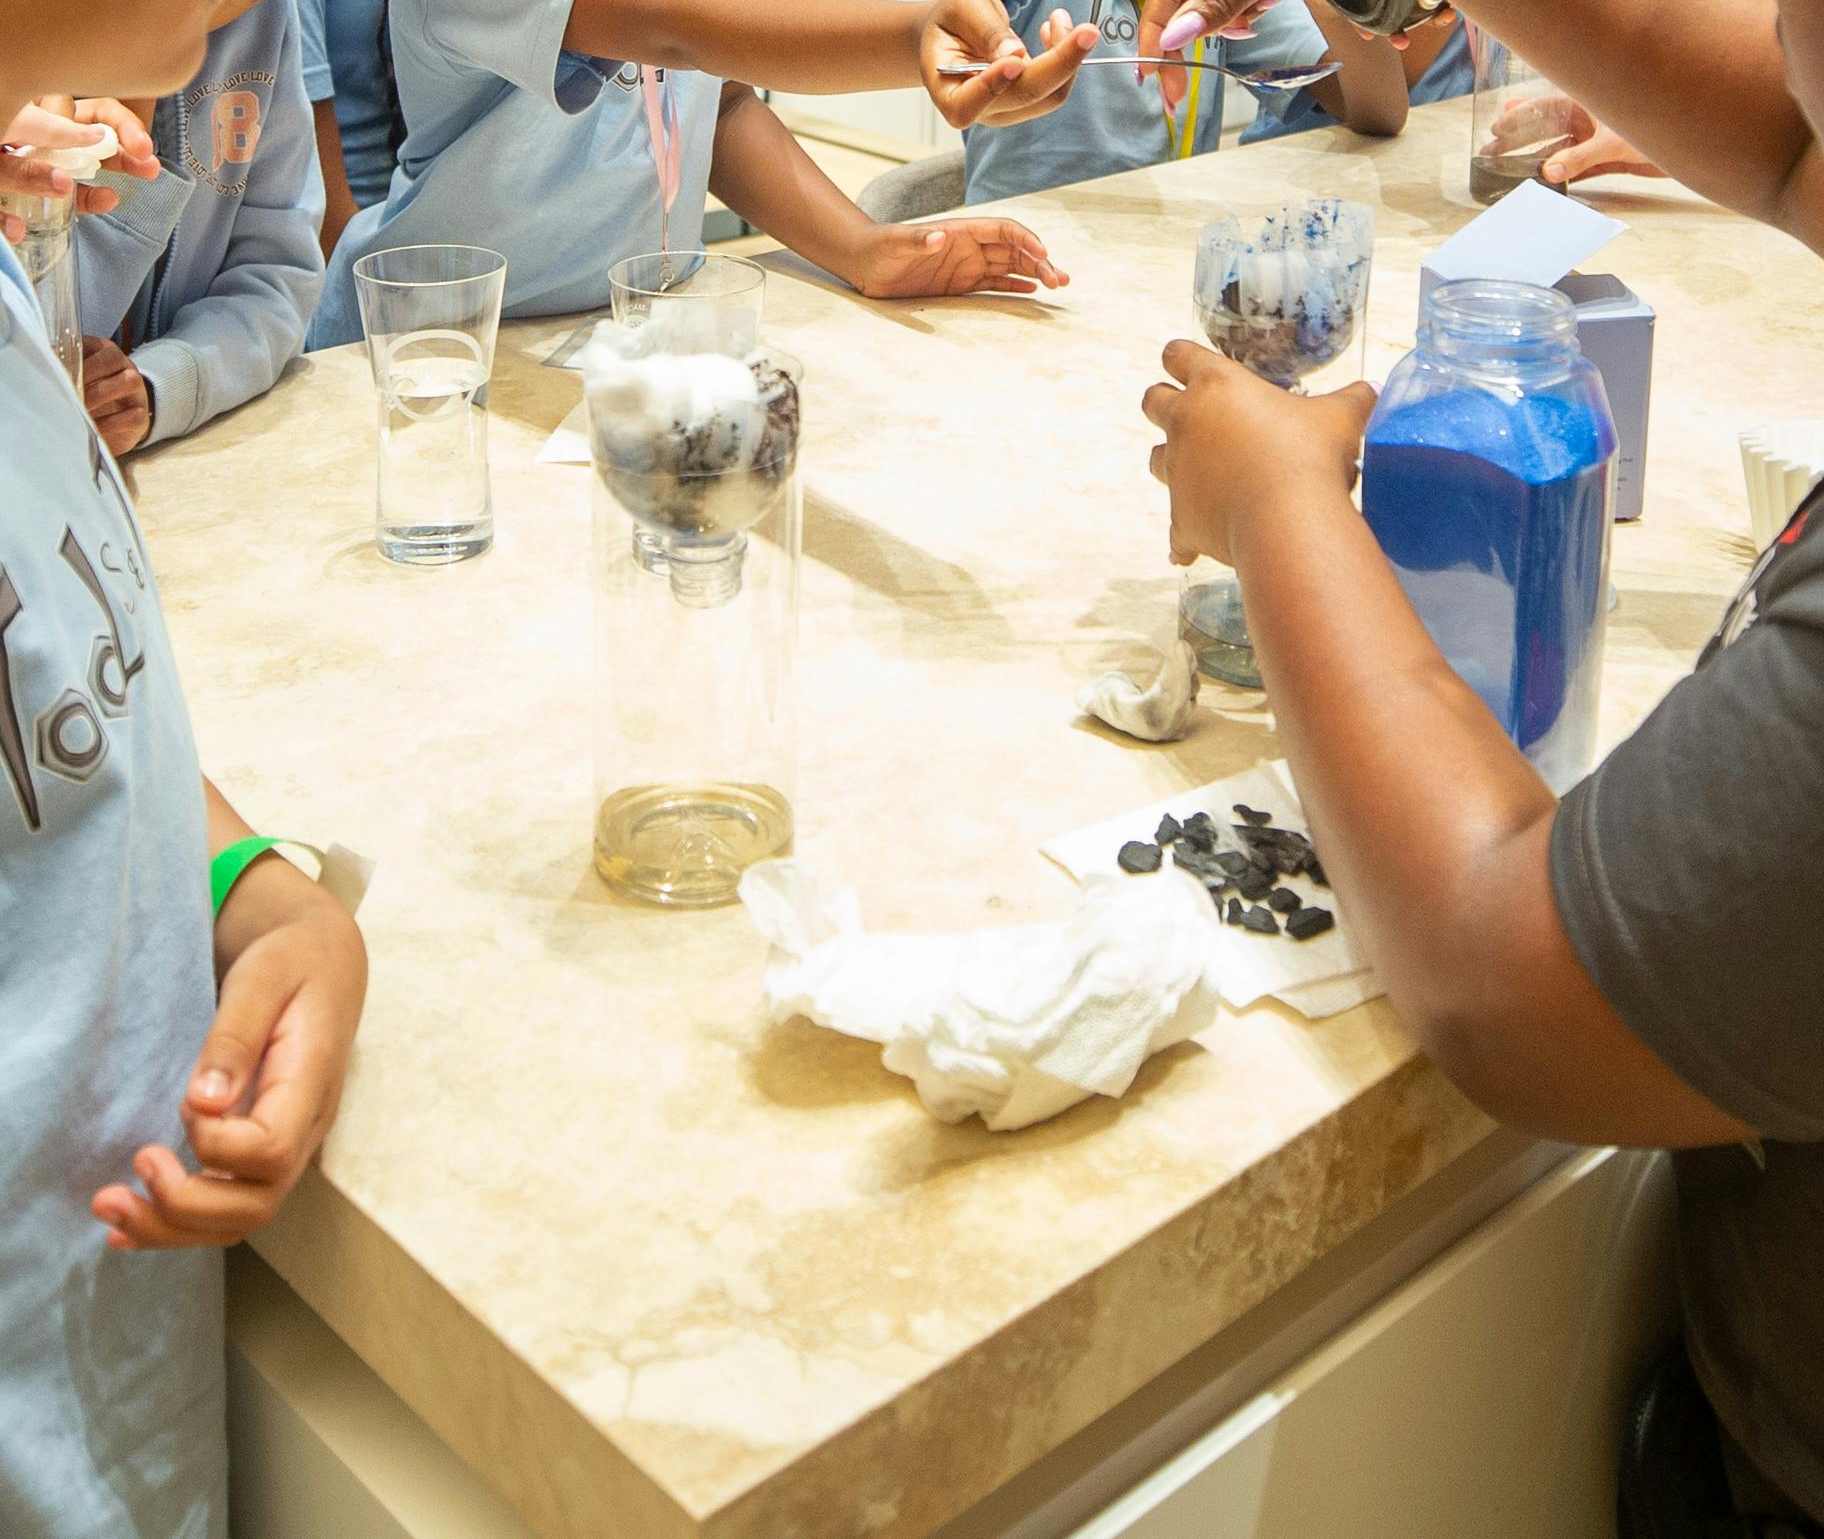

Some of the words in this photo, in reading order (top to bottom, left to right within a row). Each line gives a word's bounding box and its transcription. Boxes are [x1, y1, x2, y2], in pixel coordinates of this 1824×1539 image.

[186, 85, 211, 107] LOVE
[223, 72, 248, 90] LOVE
[250, 71, 275, 86] LOVE
